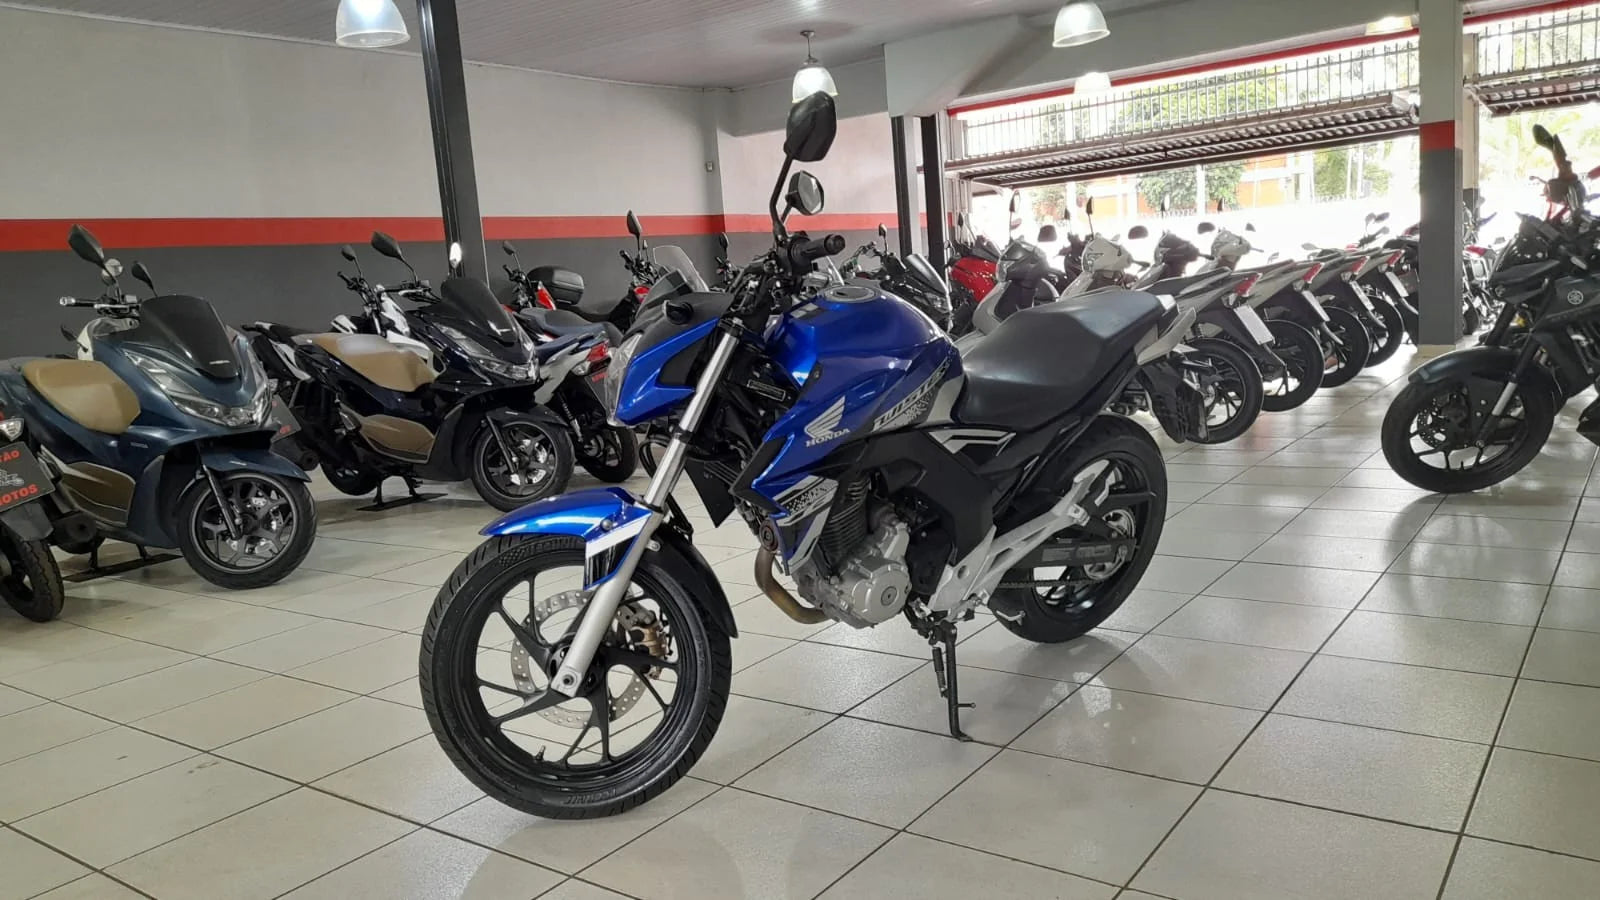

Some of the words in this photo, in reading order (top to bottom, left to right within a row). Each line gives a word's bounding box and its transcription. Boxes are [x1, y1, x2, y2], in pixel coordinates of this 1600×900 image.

[806, 428, 850, 448] HONDA
[0, 449, 20, 463] ÃO
[0, 483, 38, 505] OTOS
